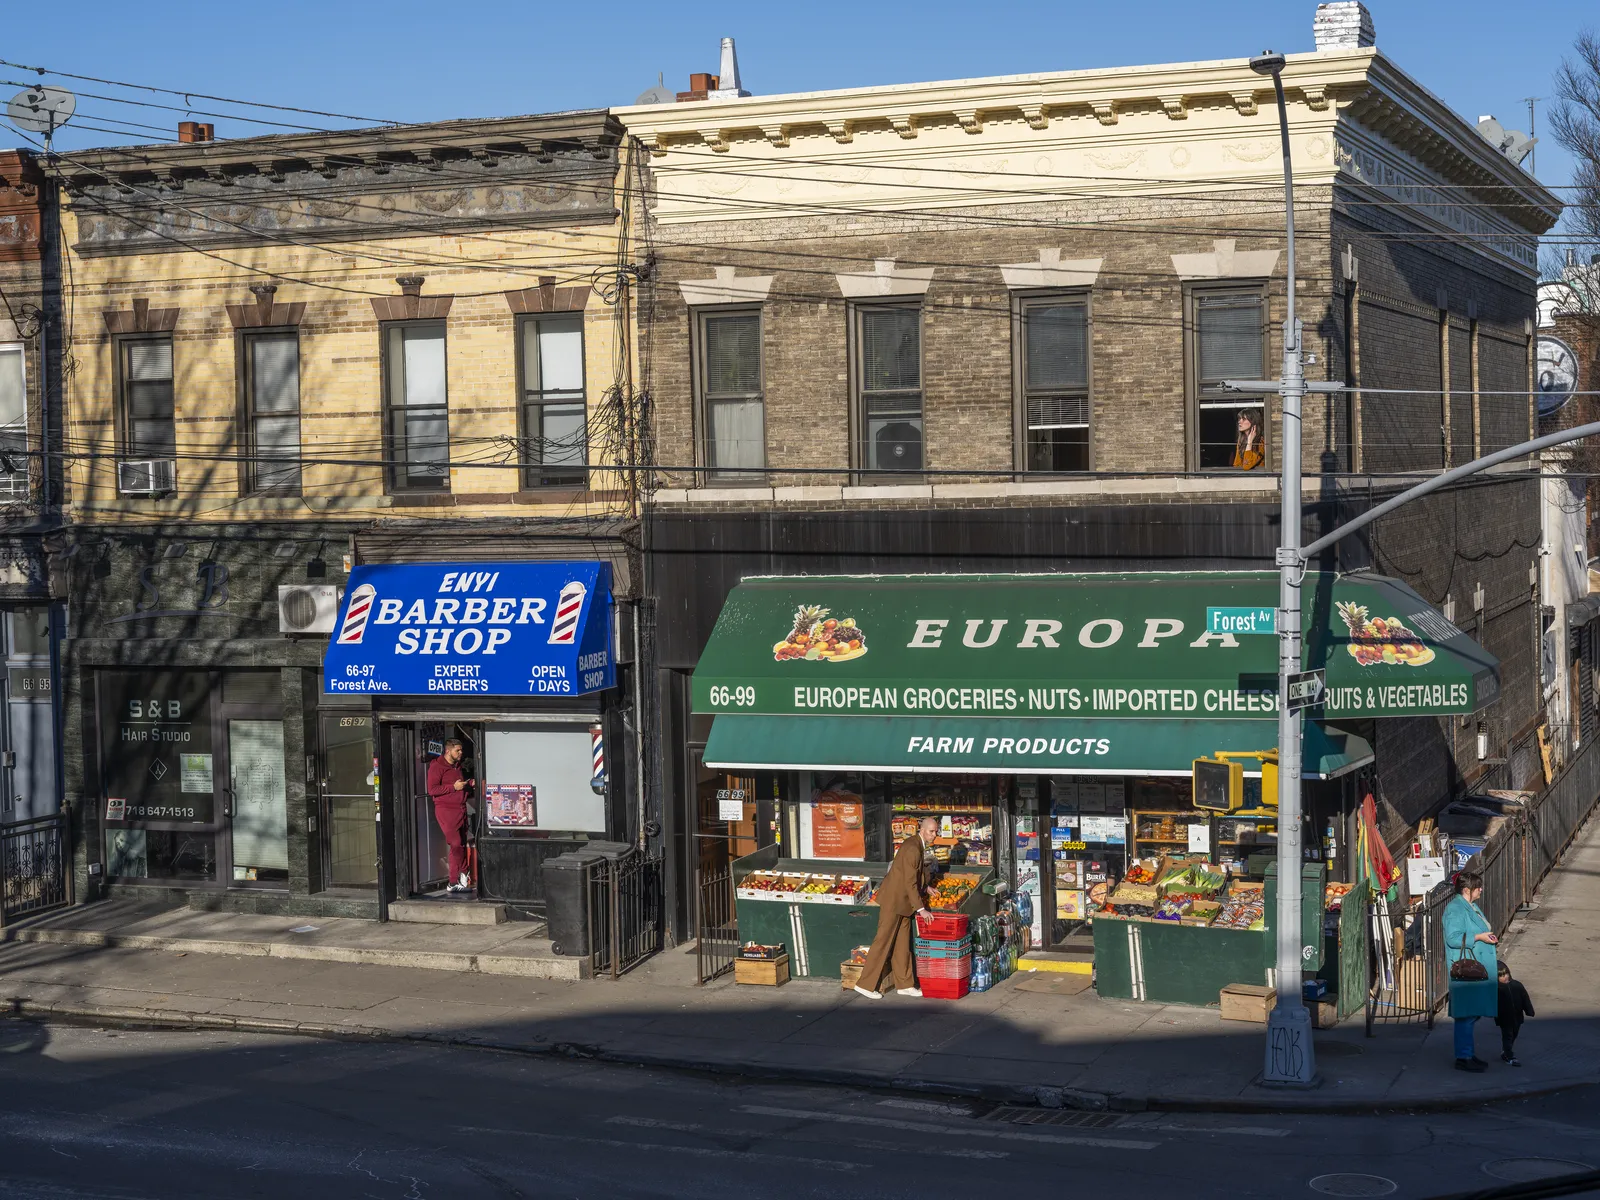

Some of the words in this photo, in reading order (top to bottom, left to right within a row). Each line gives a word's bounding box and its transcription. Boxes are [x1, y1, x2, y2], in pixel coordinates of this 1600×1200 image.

[438, 571, 500, 593] ENYI
[373, 597, 547, 625] BARBER
[1213, 611, 1256, 631] Forest
[1259, 610, 1270, 622] Av
[907, 618, 1240, 648] EUROPA
[395, 628, 512, 655] SHOP
[578, 651, 607, 672] BARBER
[346, 665, 375, 678] 66-97
[434, 665, 481, 677] EXPERT
[531, 665, 566, 678] OPEN
[24, 679, 34, 689] 66
[40, 679, 50, 689] 95
[331, 678, 365, 691] Forest
[368, 678, 392, 691] Ave.
[428, 679, 489, 691] BARBER'S
[528, 680, 534, 691] 7
[538, 680, 570, 692] DAYS
[584, 670, 604, 690] SHOP
[709, 685, 756, 707] 66-99
[794, 686, 898, 708] EUROPEAN
[1313, 687, 1362, 711] RUITS
[1366, 687, 1375, 708] &
[1378, 683, 1468, 708] VEGETABLES
[1291, 684, 1302, 698] ONE
[129, 700, 143, 718] S
[148, 700, 162, 718] &
[168, 700, 181, 718] B
[429, 743, 442, 754] OPEN
[907, 737, 974, 754] FARM
[982, 737, 1111, 755] PRODUCTS
[717, 790, 729, 798] 66
[732, 791, 744, 799] 99
[125, 806, 145, 815] 718
[147, 806, 194, 817] 647-1513
